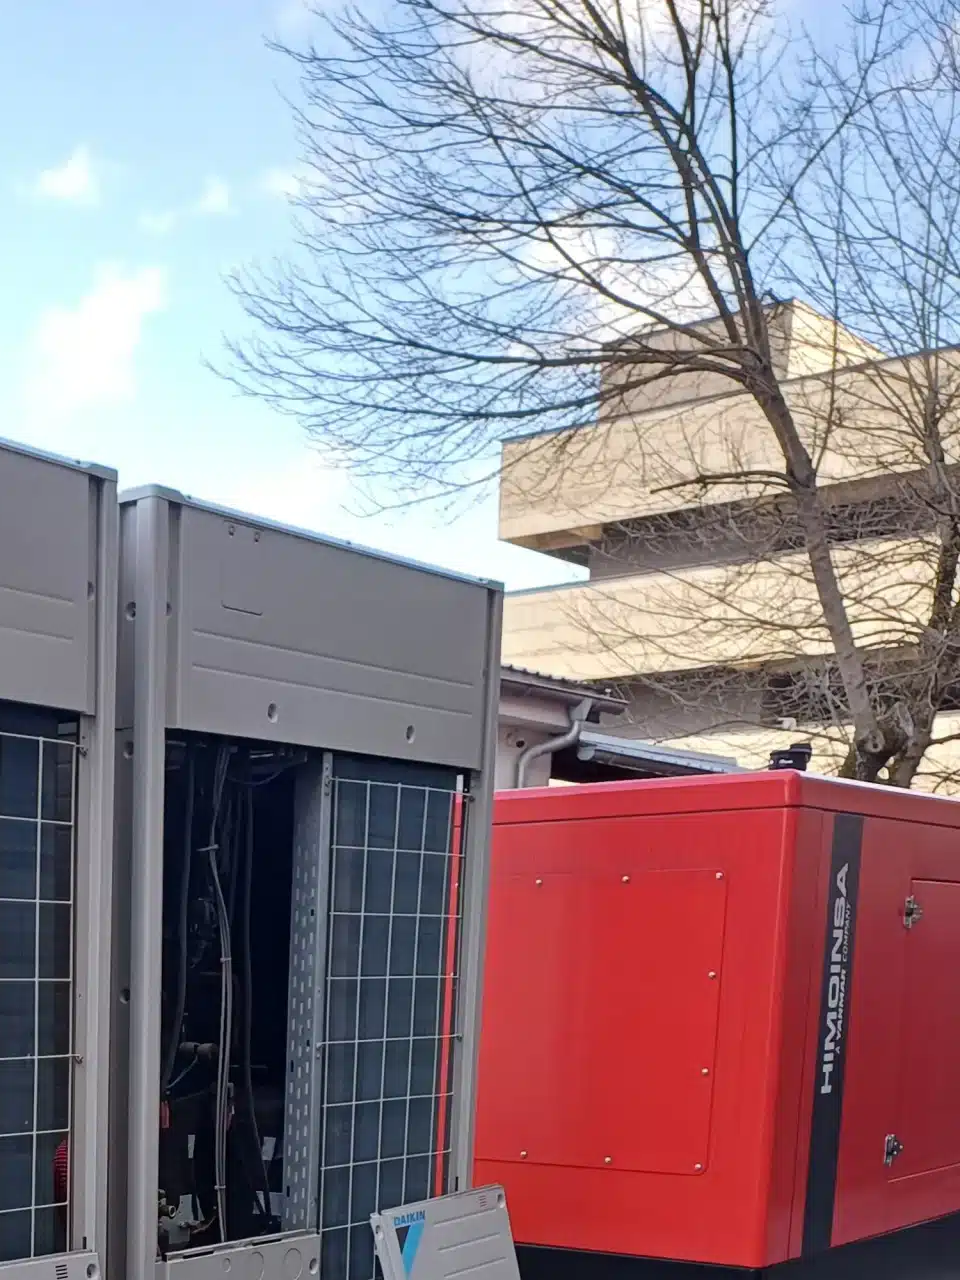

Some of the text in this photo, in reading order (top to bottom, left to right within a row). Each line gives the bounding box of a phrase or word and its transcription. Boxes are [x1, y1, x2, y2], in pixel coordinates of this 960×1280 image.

[821, 862, 850, 1095] HIMOINSA
[836, 968, 847, 1042] YANMAR
[842, 902, 853, 963] COMPANY
[393, 1210, 426, 1226] DAIKIN
